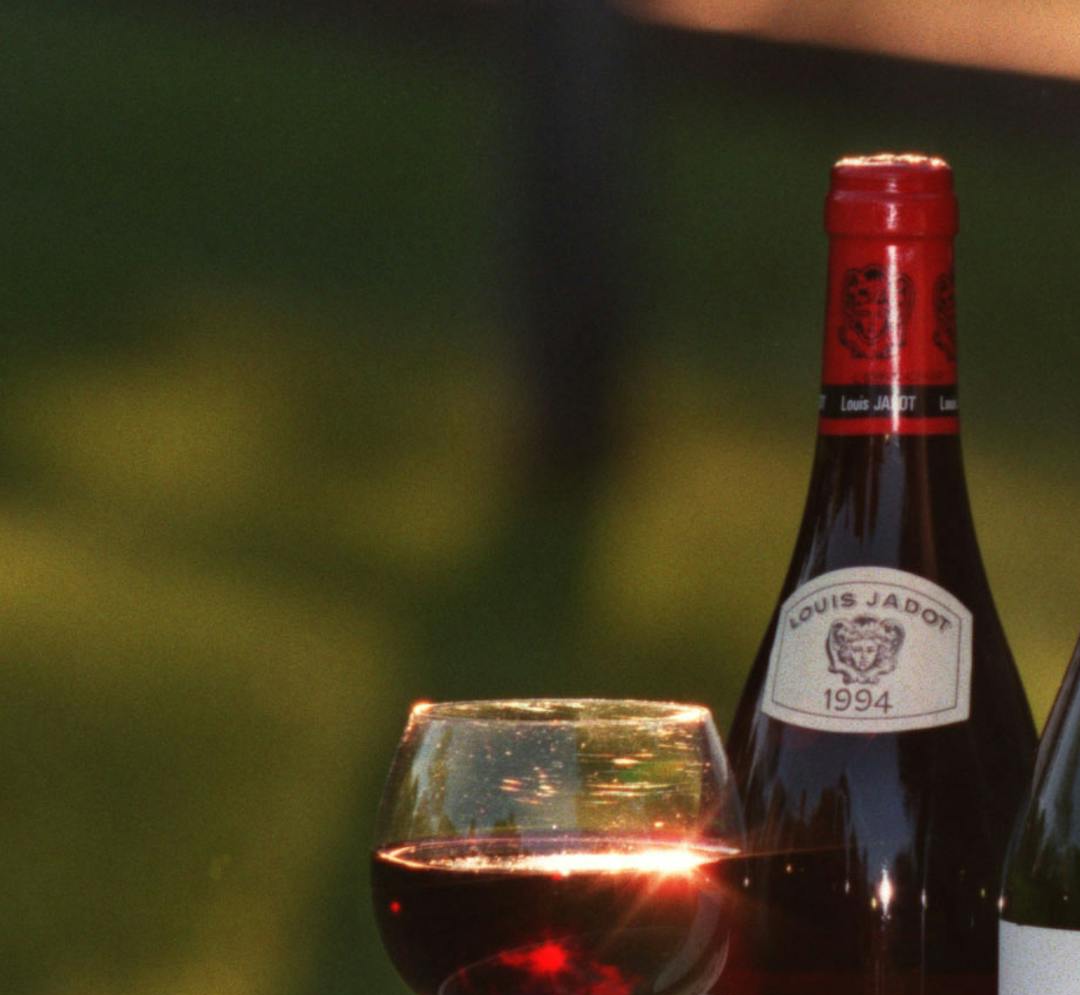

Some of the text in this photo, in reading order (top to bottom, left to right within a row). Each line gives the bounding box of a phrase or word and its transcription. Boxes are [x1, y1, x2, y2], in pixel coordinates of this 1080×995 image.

[840, 394, 870, 411] Louis
[789, 592, 953, 634] LOUIS JADOT
[824, 688, 893, 714] 1994
